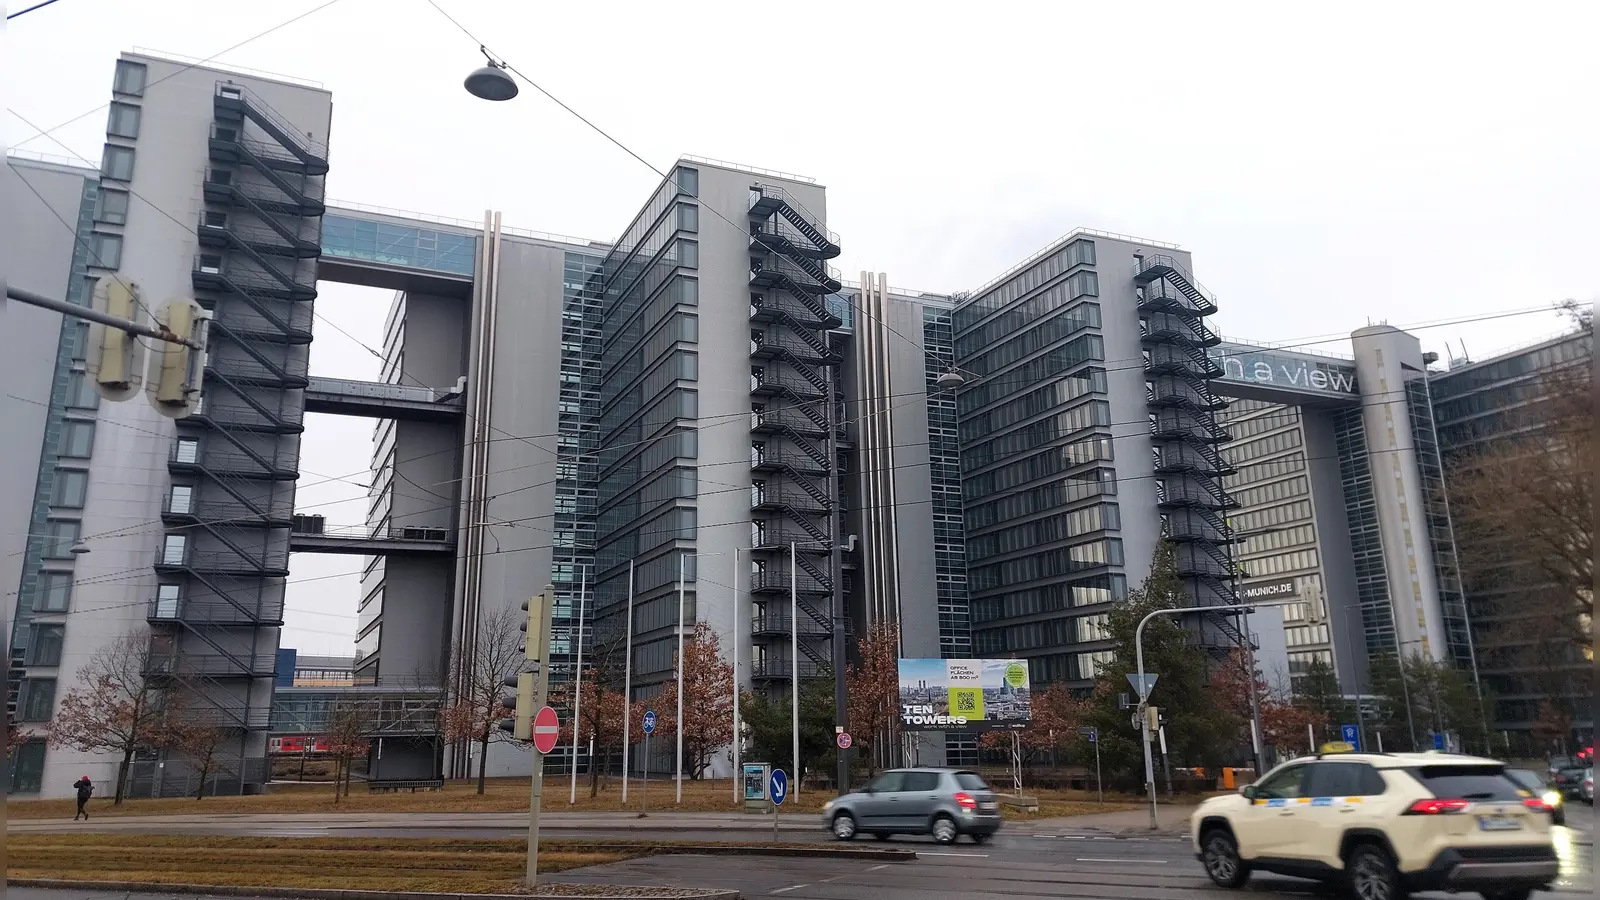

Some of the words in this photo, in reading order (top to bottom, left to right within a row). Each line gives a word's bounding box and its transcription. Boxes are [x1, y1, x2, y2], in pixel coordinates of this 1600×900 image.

[1254, 361, 1273, 382] a
[1281, 361, 1354, 393] view
[903, 705, 933, 714] TEN
[903, 715, 967, 724] TOWERS
